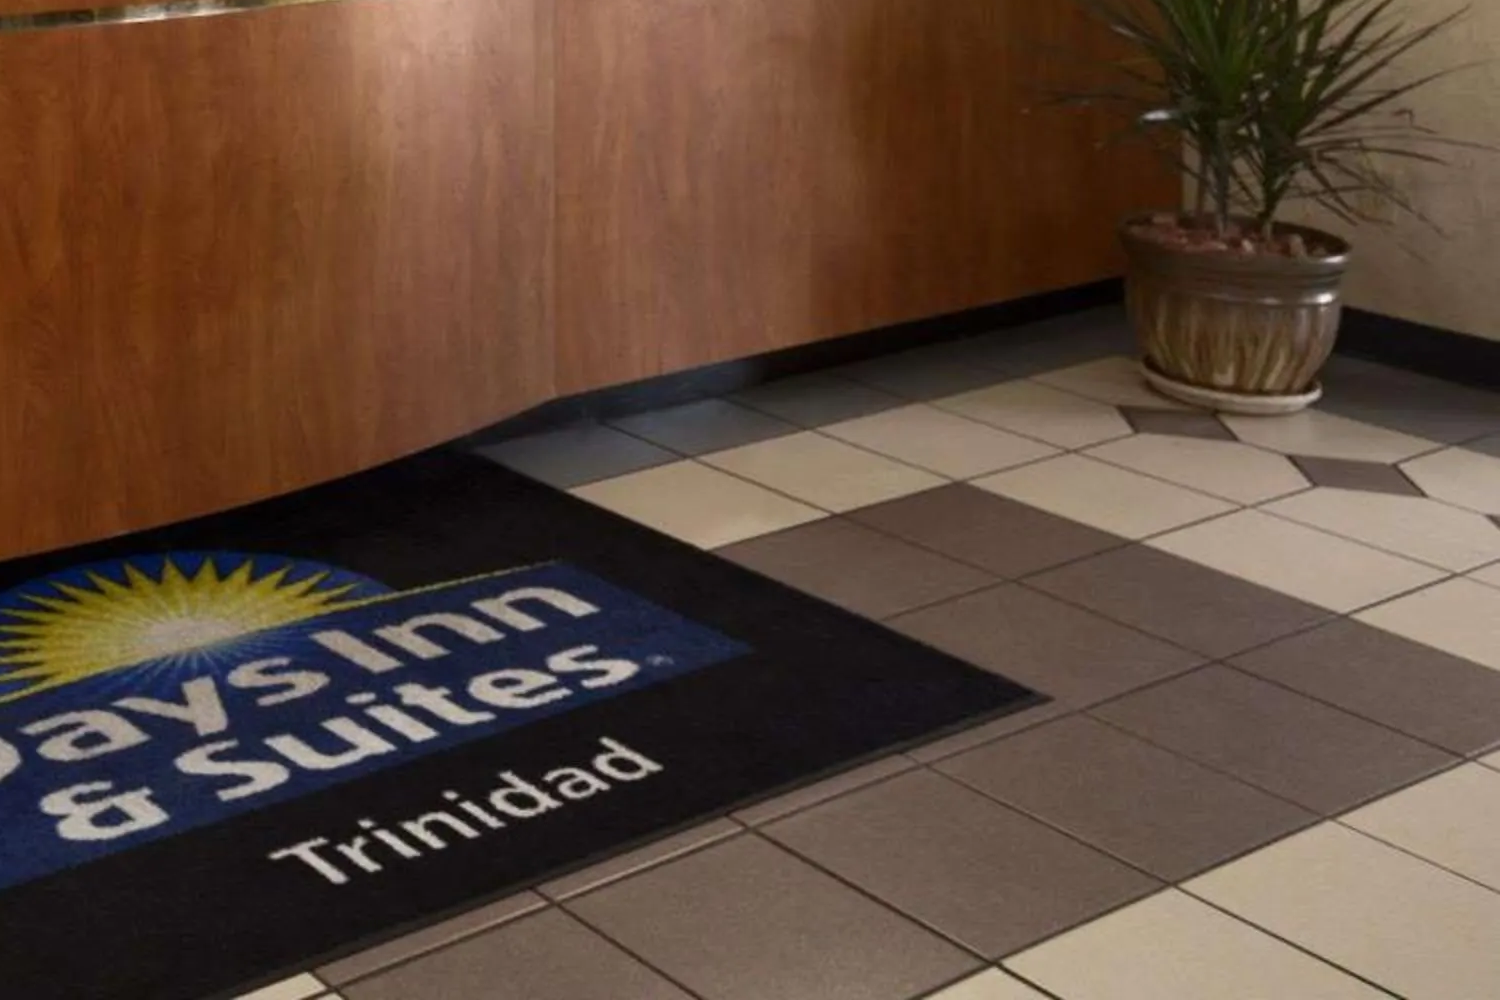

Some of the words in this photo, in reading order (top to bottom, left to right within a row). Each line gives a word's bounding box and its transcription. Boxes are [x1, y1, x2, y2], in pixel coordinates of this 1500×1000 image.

[309, 584, 600, 675] Inn
[37, 779, 171, 843] &
[174, 639, 642, 802] Suites
[268, 736, 664, 886] Trinidad
